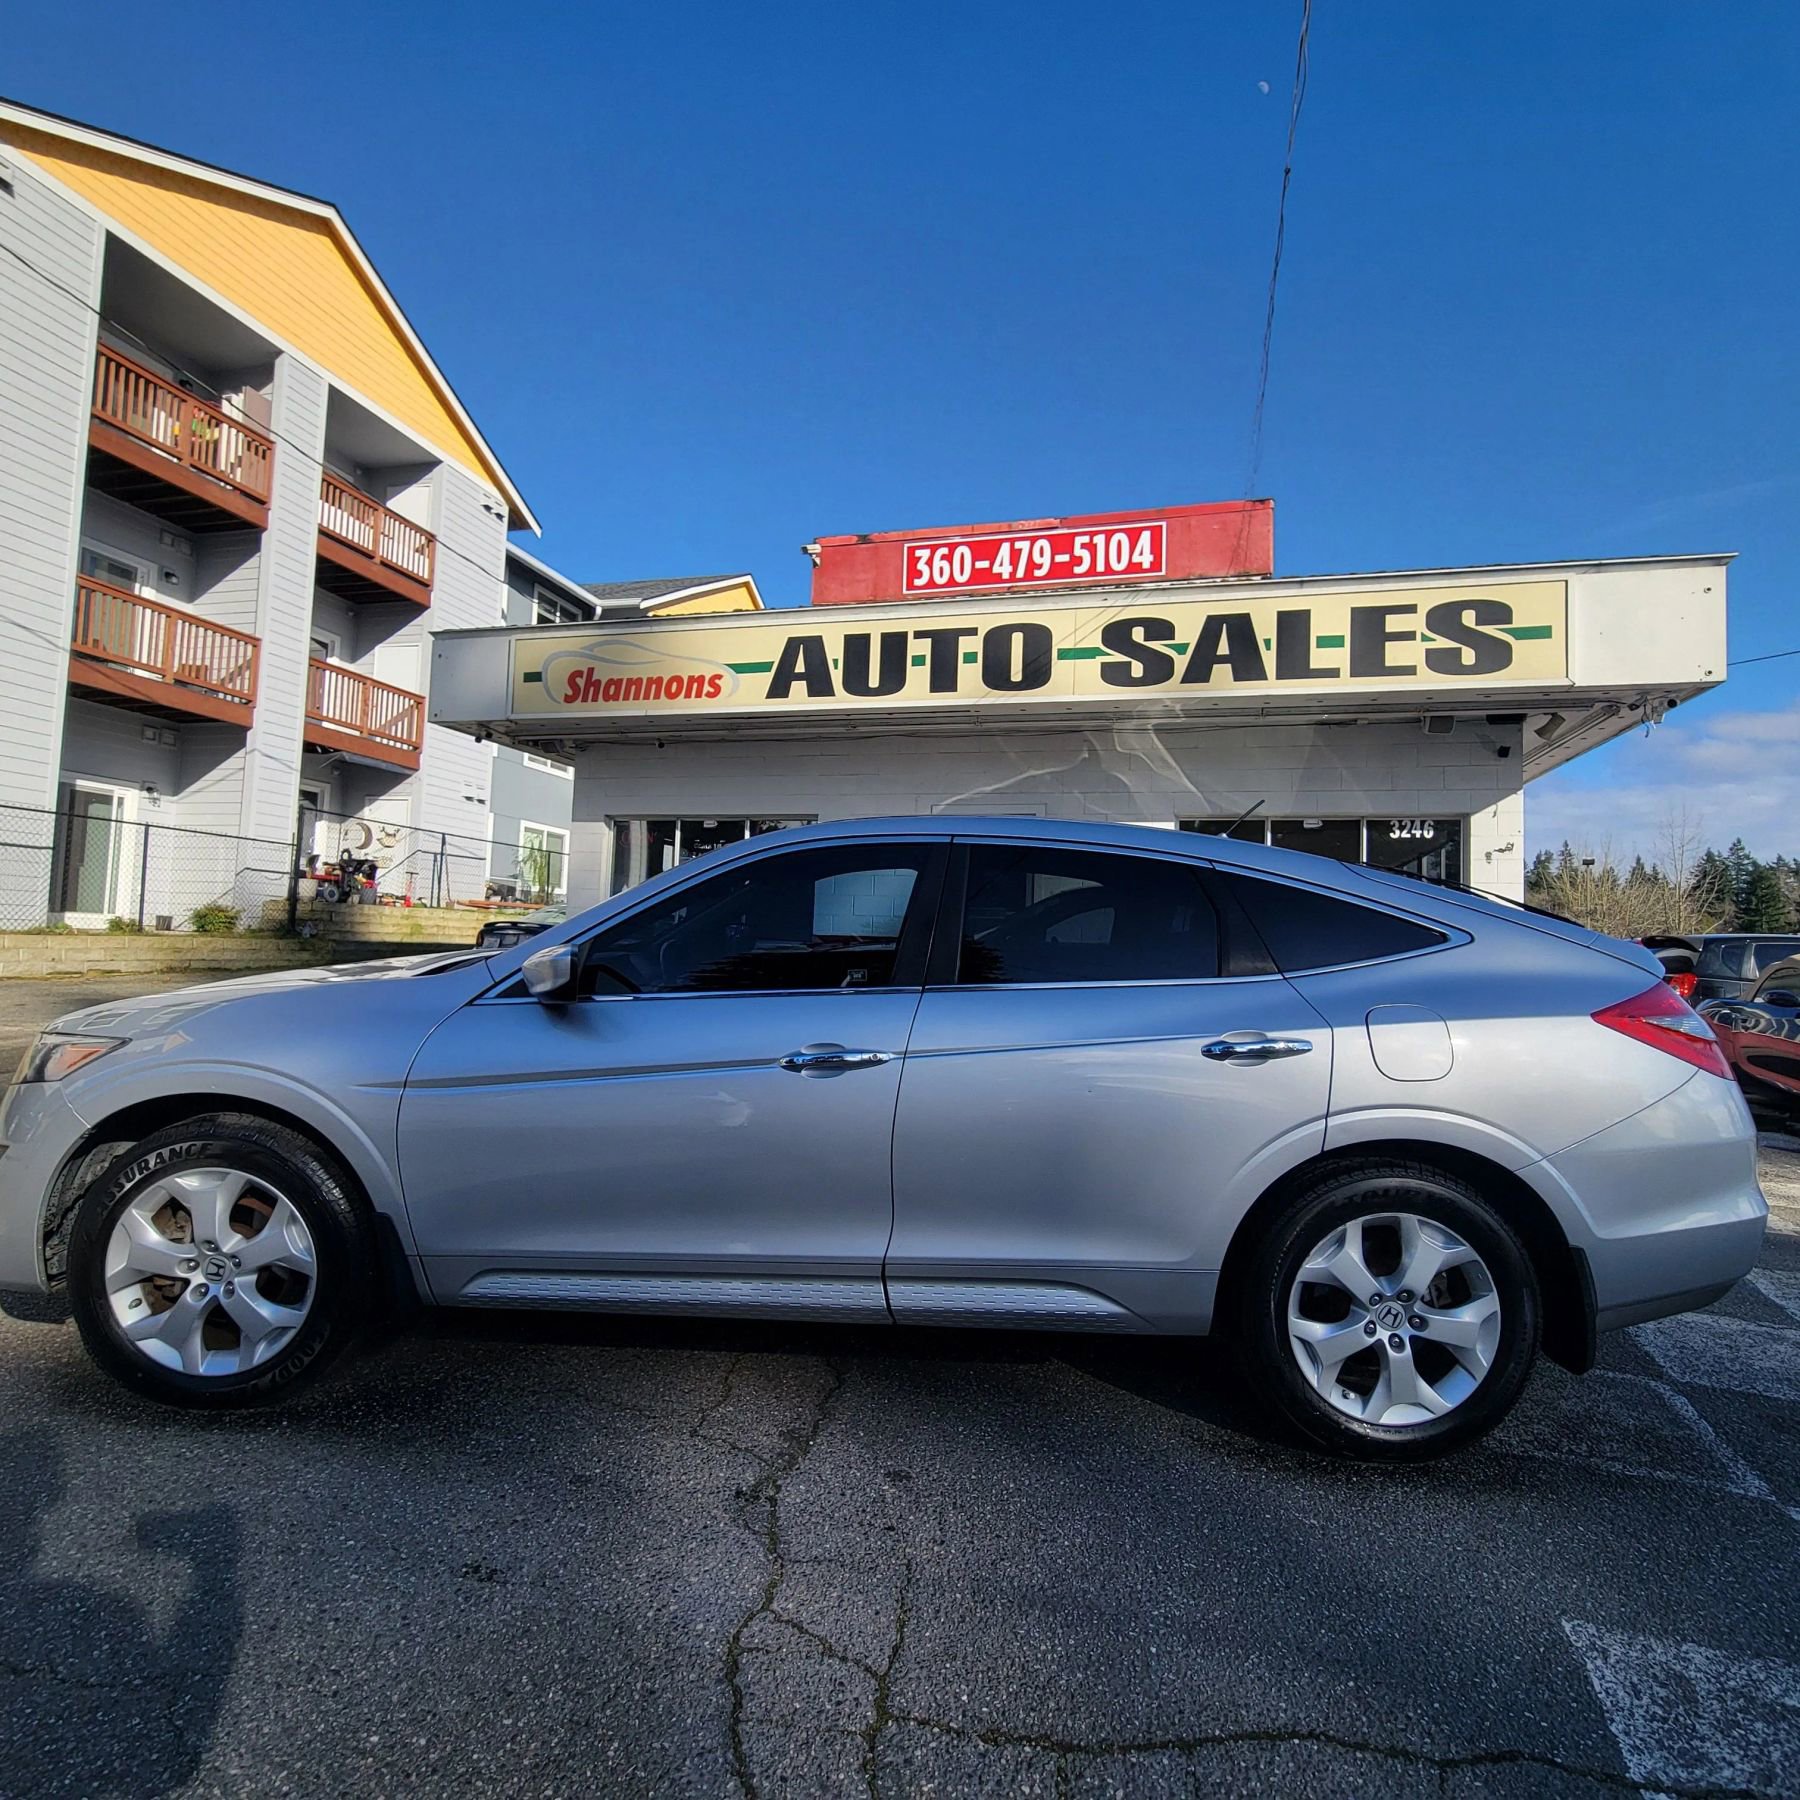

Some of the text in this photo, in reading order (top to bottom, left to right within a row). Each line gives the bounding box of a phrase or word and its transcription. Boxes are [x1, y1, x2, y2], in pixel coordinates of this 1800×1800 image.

[913, 530, 1154, 587] 360-479-5104
[563, 598, 1514, 704] Shannons AUTO SALES
[1389, 819, 1435, 839] 3246
